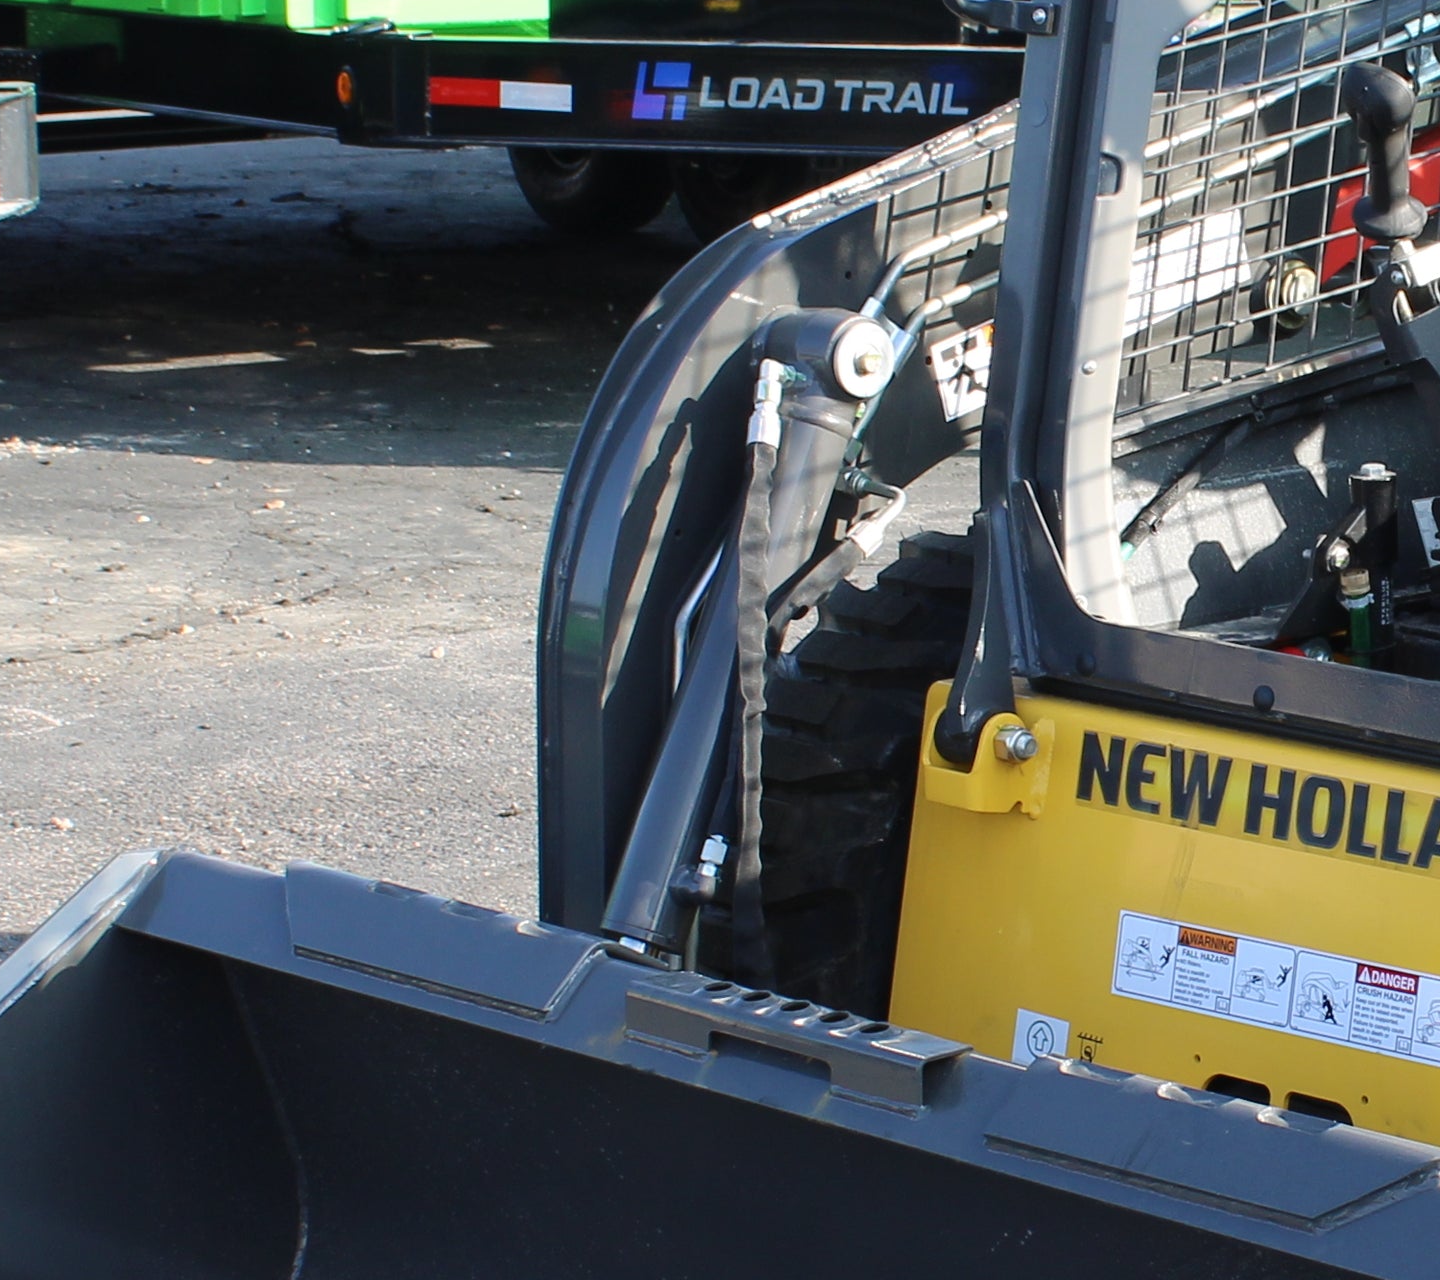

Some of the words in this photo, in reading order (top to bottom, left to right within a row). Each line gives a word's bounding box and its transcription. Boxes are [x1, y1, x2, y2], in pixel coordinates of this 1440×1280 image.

[699, 74, 826, 112] LOAD
[835, 78, 970, 116] TRAIL
[1075, 729, 1233, 827] NEW
[1189, 932, 1235, 953] WARNING
[1182, 948, 1199, 960] FALL
[1200, 952, 1230, 966] HAZARD
[1371, 969, 1416, 992] DANGER
[1356, 986, 1382, 999] CRUSH
[1383, 991, 1415, 1005] HAZARD
